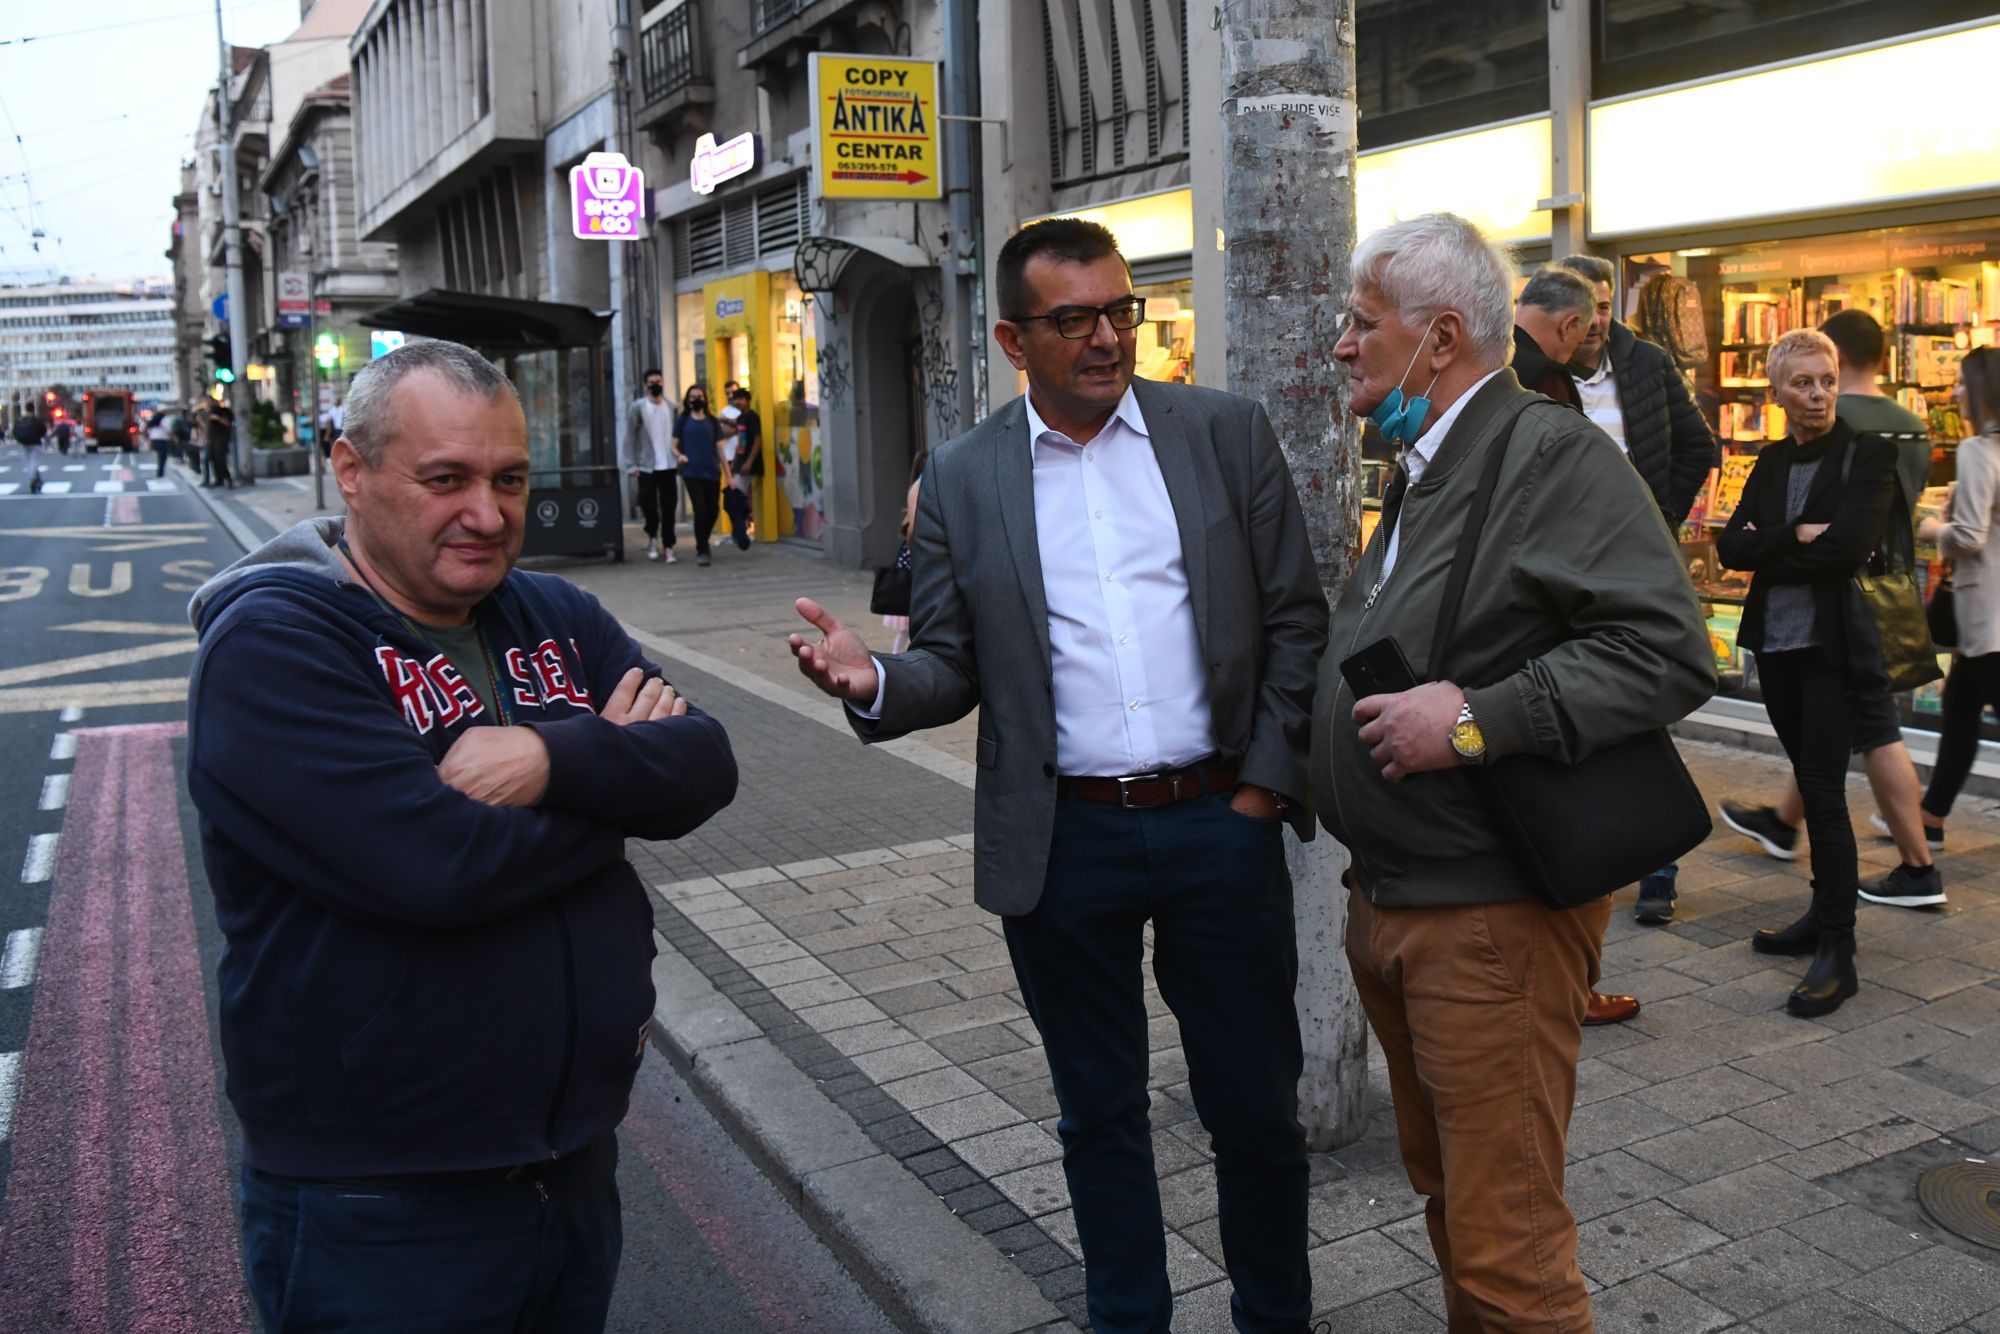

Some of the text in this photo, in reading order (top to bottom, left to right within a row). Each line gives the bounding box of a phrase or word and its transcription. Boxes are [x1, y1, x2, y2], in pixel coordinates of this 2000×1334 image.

[845, 68, 908, 87] COPY
[832, 88, 926, 134] ANTIKA
[1281, 103, 1316, 115] BUDE
[836, 142, 923, 160] CENTAR
[837, 161, 899, 172] 063/295-576
[584, 198, 636, 216] SHOP
[0, 560, 214, 601] BUS
